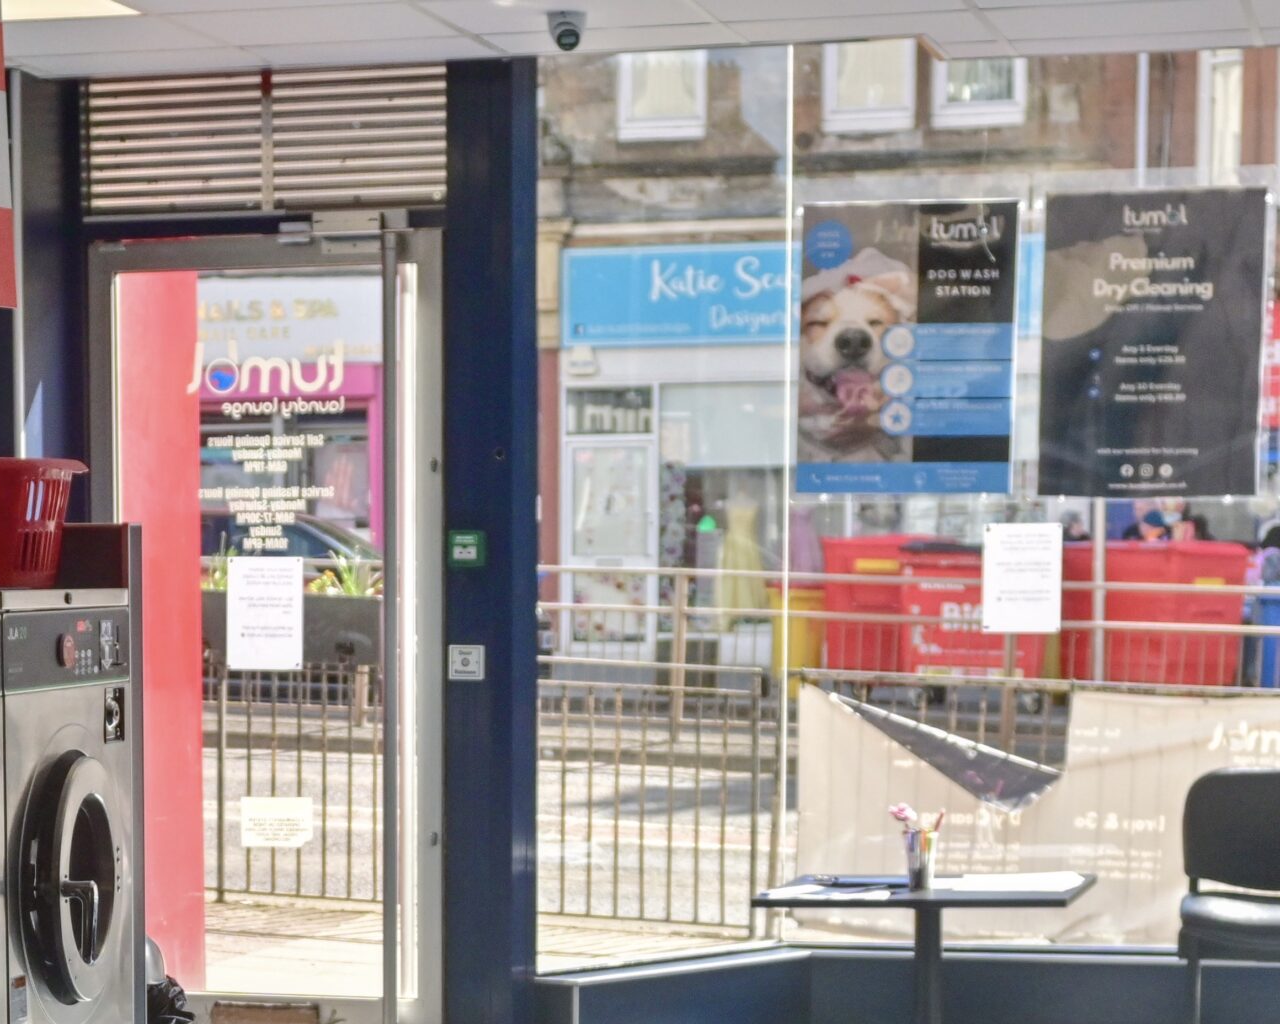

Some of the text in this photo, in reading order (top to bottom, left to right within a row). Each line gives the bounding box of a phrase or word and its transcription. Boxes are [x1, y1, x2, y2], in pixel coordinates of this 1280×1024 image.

[1110, 252, 1194, 271] Premium
[649, 259, 721, 302] Katie
[927, 268, 1000, 280] DOG WASH
[935, 286, 992, 297] STATION
[1093, 277, 1213, 300] Dry Cleaning
